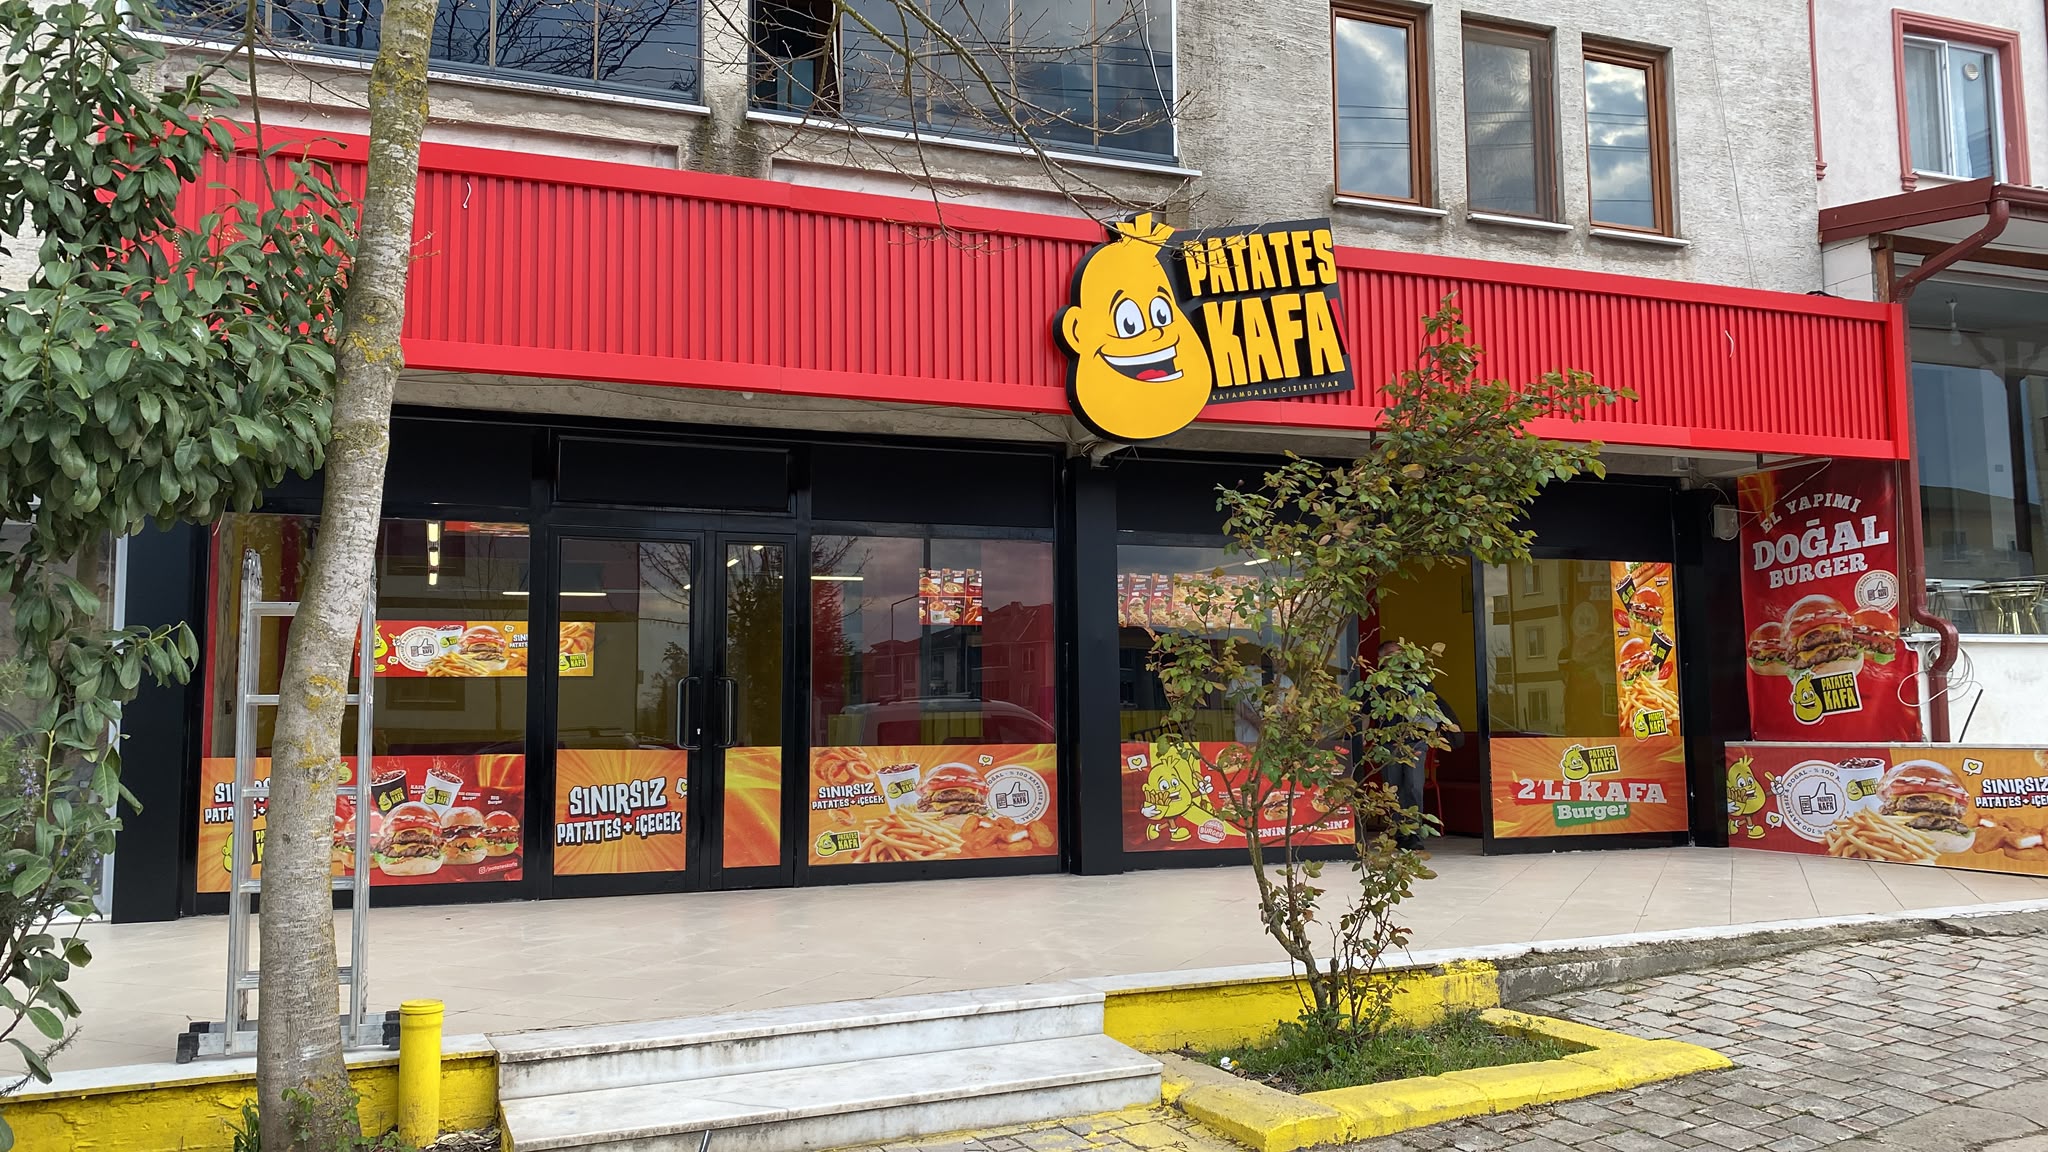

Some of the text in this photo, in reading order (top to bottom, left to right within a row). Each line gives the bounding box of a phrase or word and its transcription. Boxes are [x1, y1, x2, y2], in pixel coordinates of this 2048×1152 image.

[1183, 229, 1337, 296] PATATES
[1203, 291, 1346, 387] KAFA
[1212, 380, 1340, 400] KAFAMDA BİR CIZIRTI VAR
[1760, 493, 1862, 534] EL YAPIMI
[1753, 515, 1889, 571] DOĞAL
[1769, 553, 1868, 589] BURGER
[1821, 673, 1854, 691] PATATES
[1823, 688, 1858, 710] KAFA
[1588, 748, 1615, 758] PATATES
[1590, 757, 1617, 772] KAFA
[818, 782, 875, 798] SINIRSIZ
[1580, 781, 1667, 803] KAFA
[1982, 776, 2048, 795] SINIRSIZ
[569, 777, 667, 815] SINIRSIZ
[812, 799, 850, 810] PATATES
[1975, 796, 2021, 807] PATATES
[1557, 803, 1628, 820] Burger
[556, 818, 621, 843] PATATES
[1200, 826, 1225, 839] BURGER
[838, 838, 859, 850] KAFA
